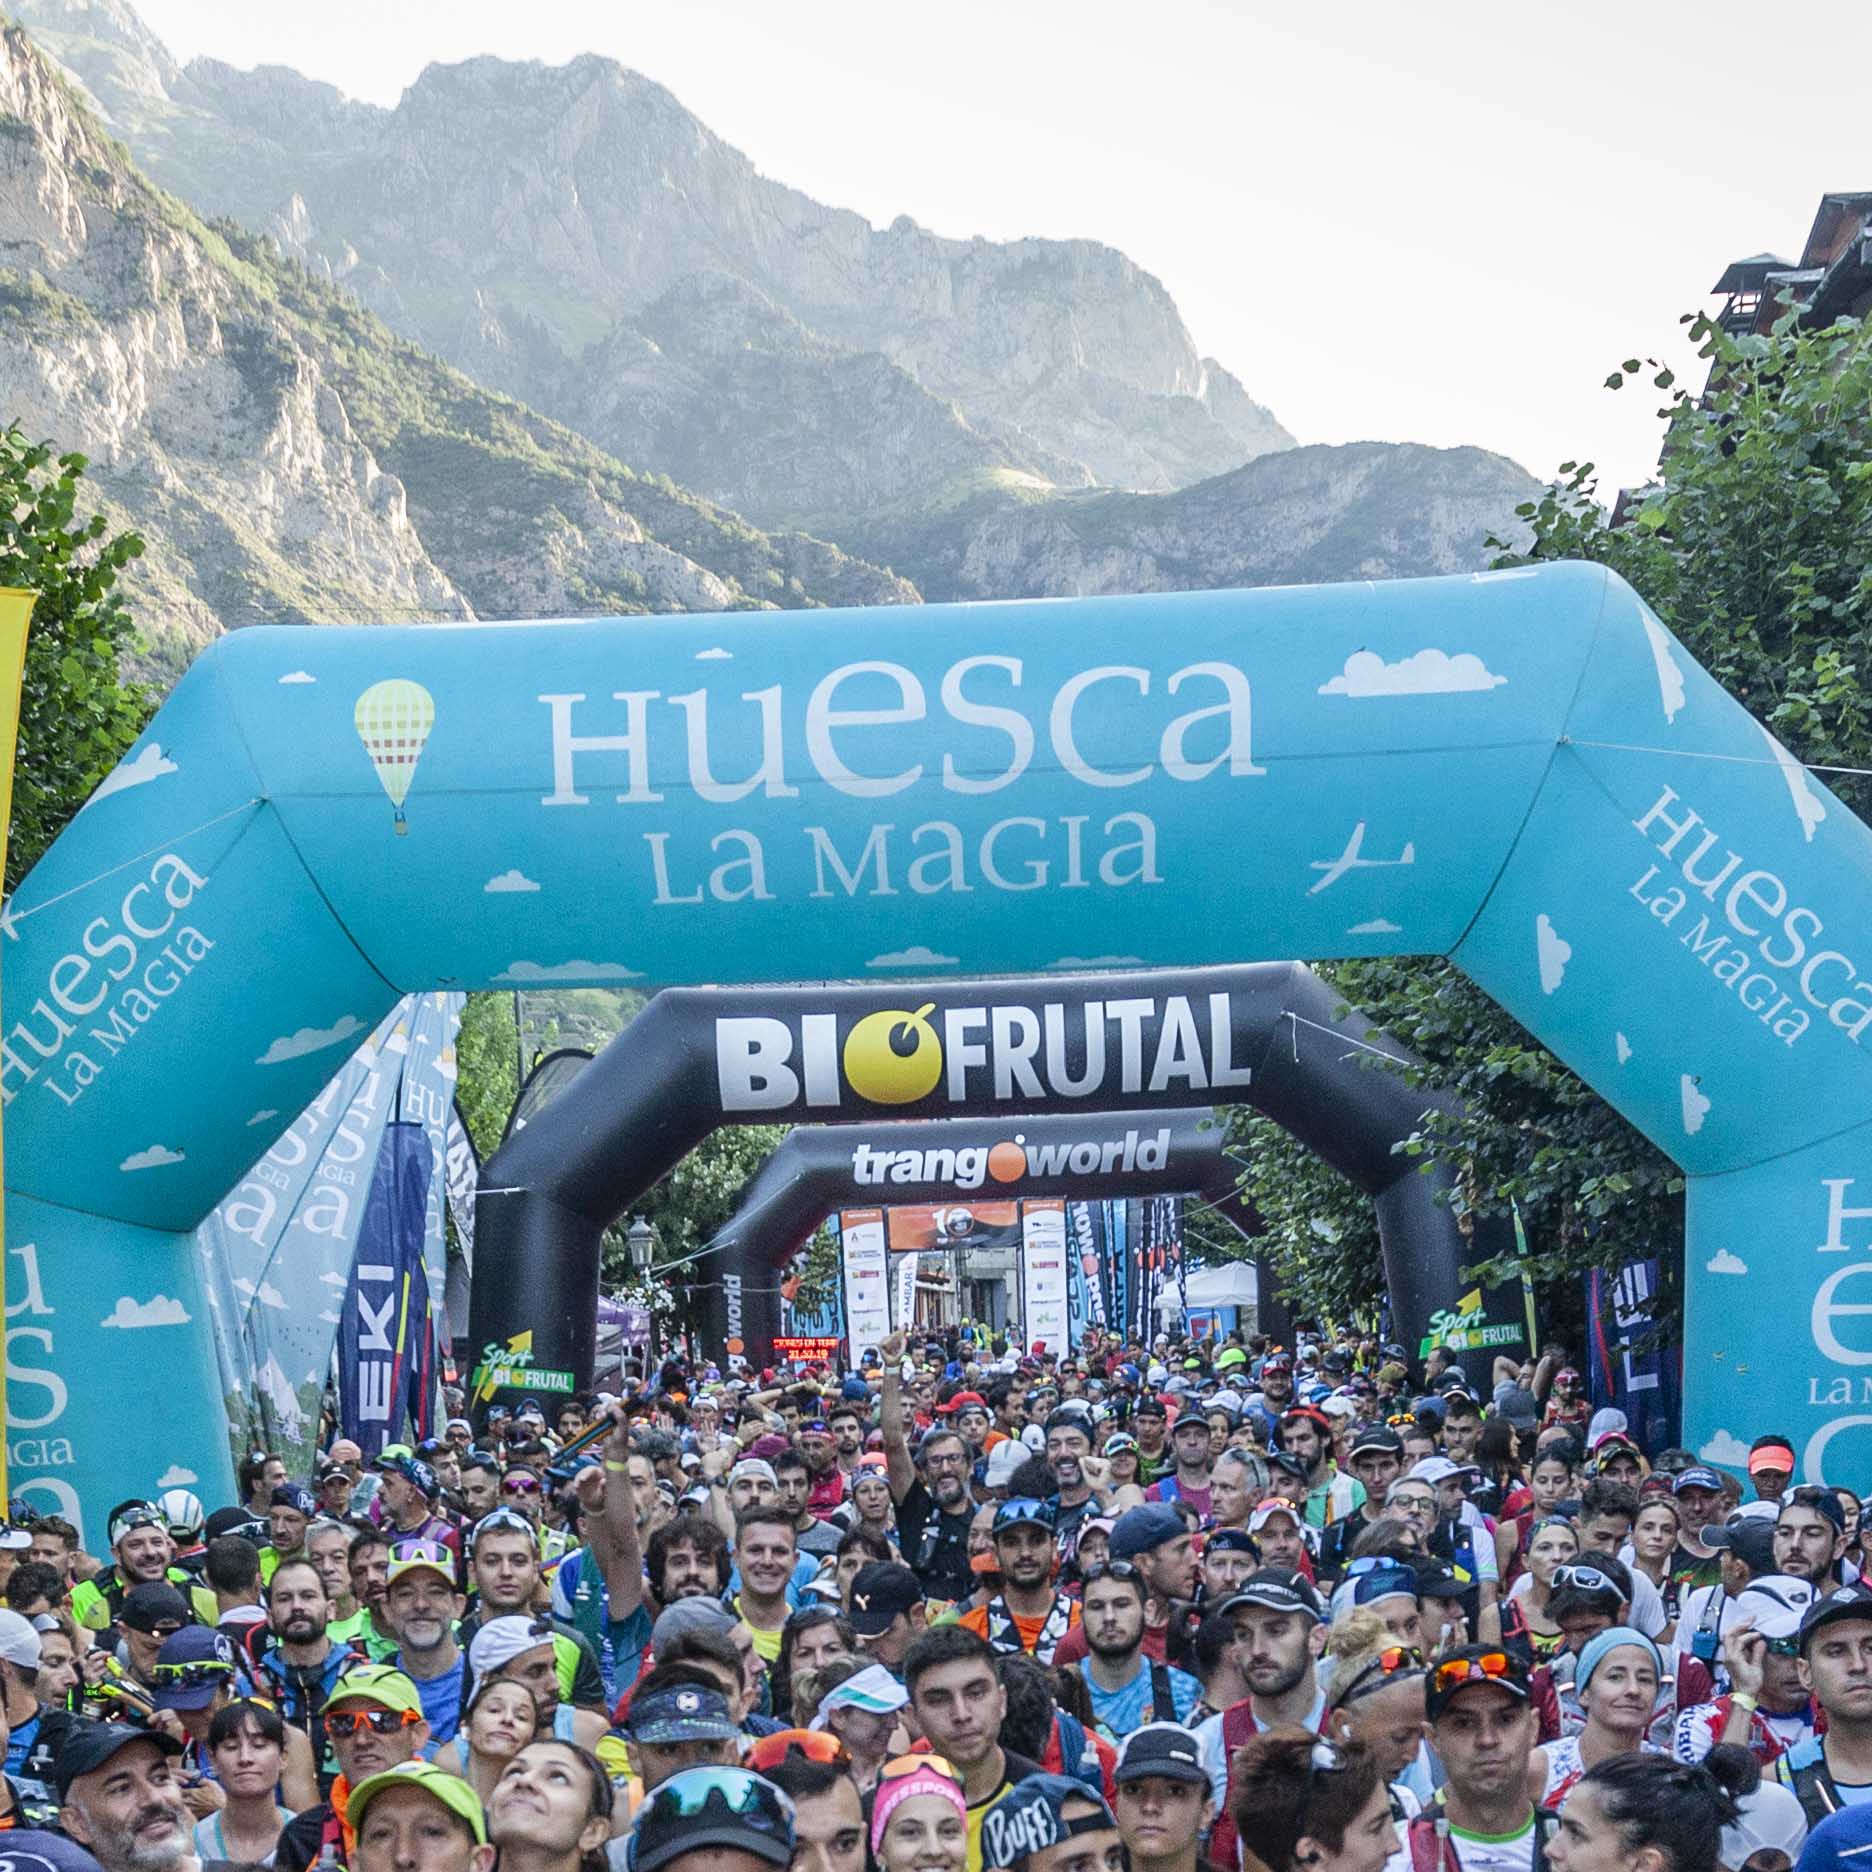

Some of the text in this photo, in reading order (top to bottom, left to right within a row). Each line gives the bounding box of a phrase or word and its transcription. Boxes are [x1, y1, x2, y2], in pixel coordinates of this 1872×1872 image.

[538, 653, 1266, 807] Huesca
[642, 826, 776, 907] La
[1627, 862, 1677, 927] La
[0, 850, 209, 1108] Huesca
[43, 1050, 103, 1108] La
[714, 990, 1254, 1114] BIOFRUTAL
[850, 1126, 1172, 1189] trangoworld
[903, 1271, 914, 1315] AMBAR
[1428, 1306, 1488, 1339] Sport
[480, 1342, 535, 1371] Sport
[491, 1370, 570, 1393] BIOFRUTAL
